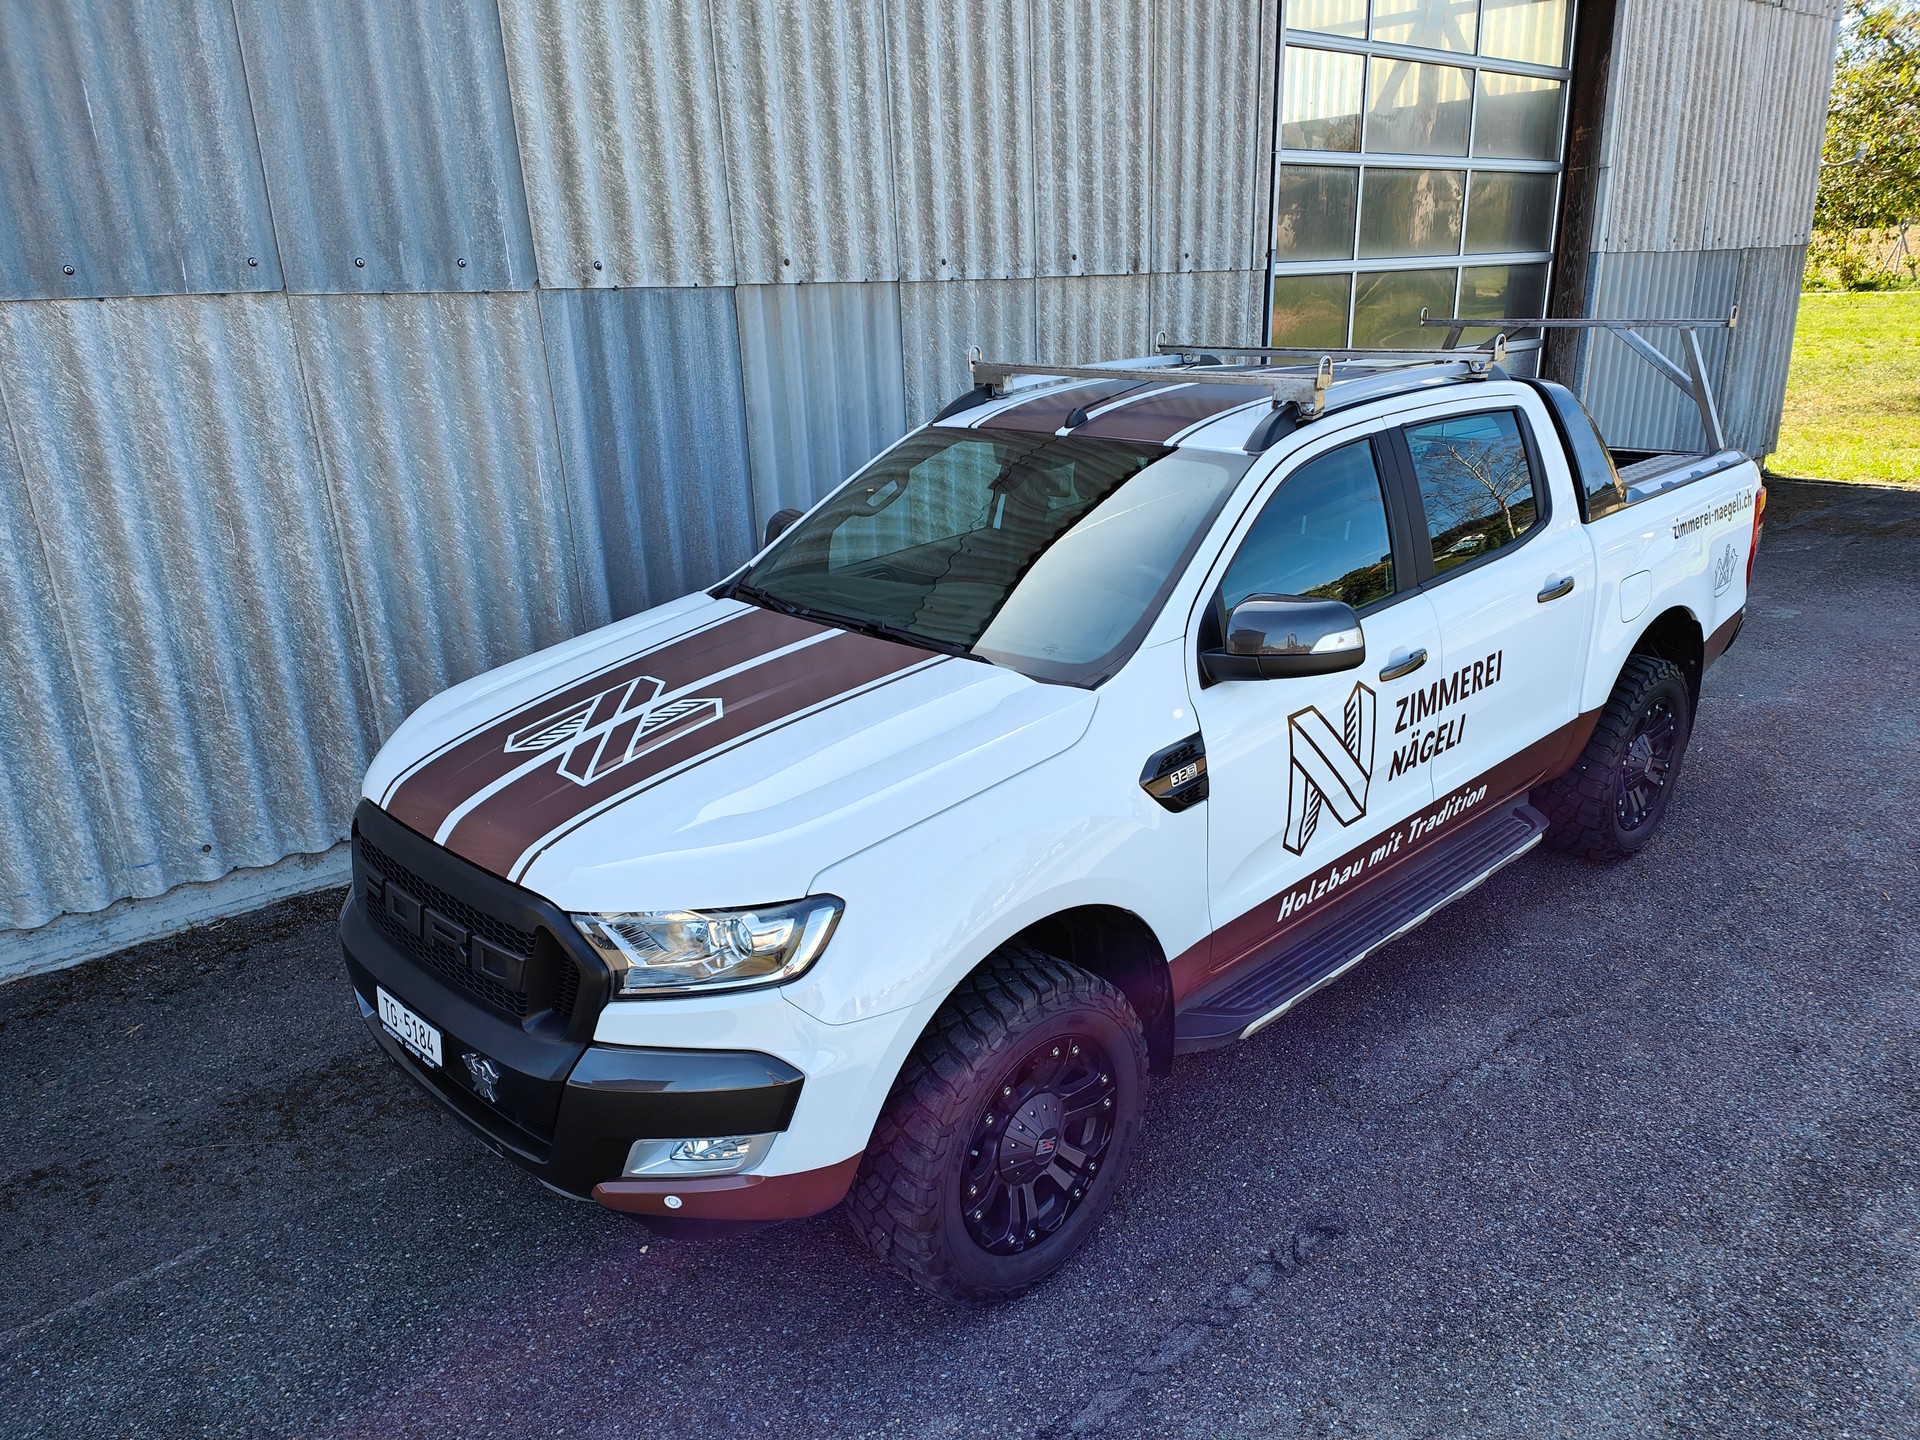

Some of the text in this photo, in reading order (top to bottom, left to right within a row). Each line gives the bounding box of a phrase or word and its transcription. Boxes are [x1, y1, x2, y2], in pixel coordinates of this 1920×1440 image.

[1672, 490, 1753, 540] zimmerei-naegeli.ch
[1394, 650, 1503, 735] ZIMMEREI
[1388, 713, 1466, 782] NÄGELI
[1276, 784, 1488, 922] Holzbau mit Tradition
[356, 864, 527, 995] FORD
